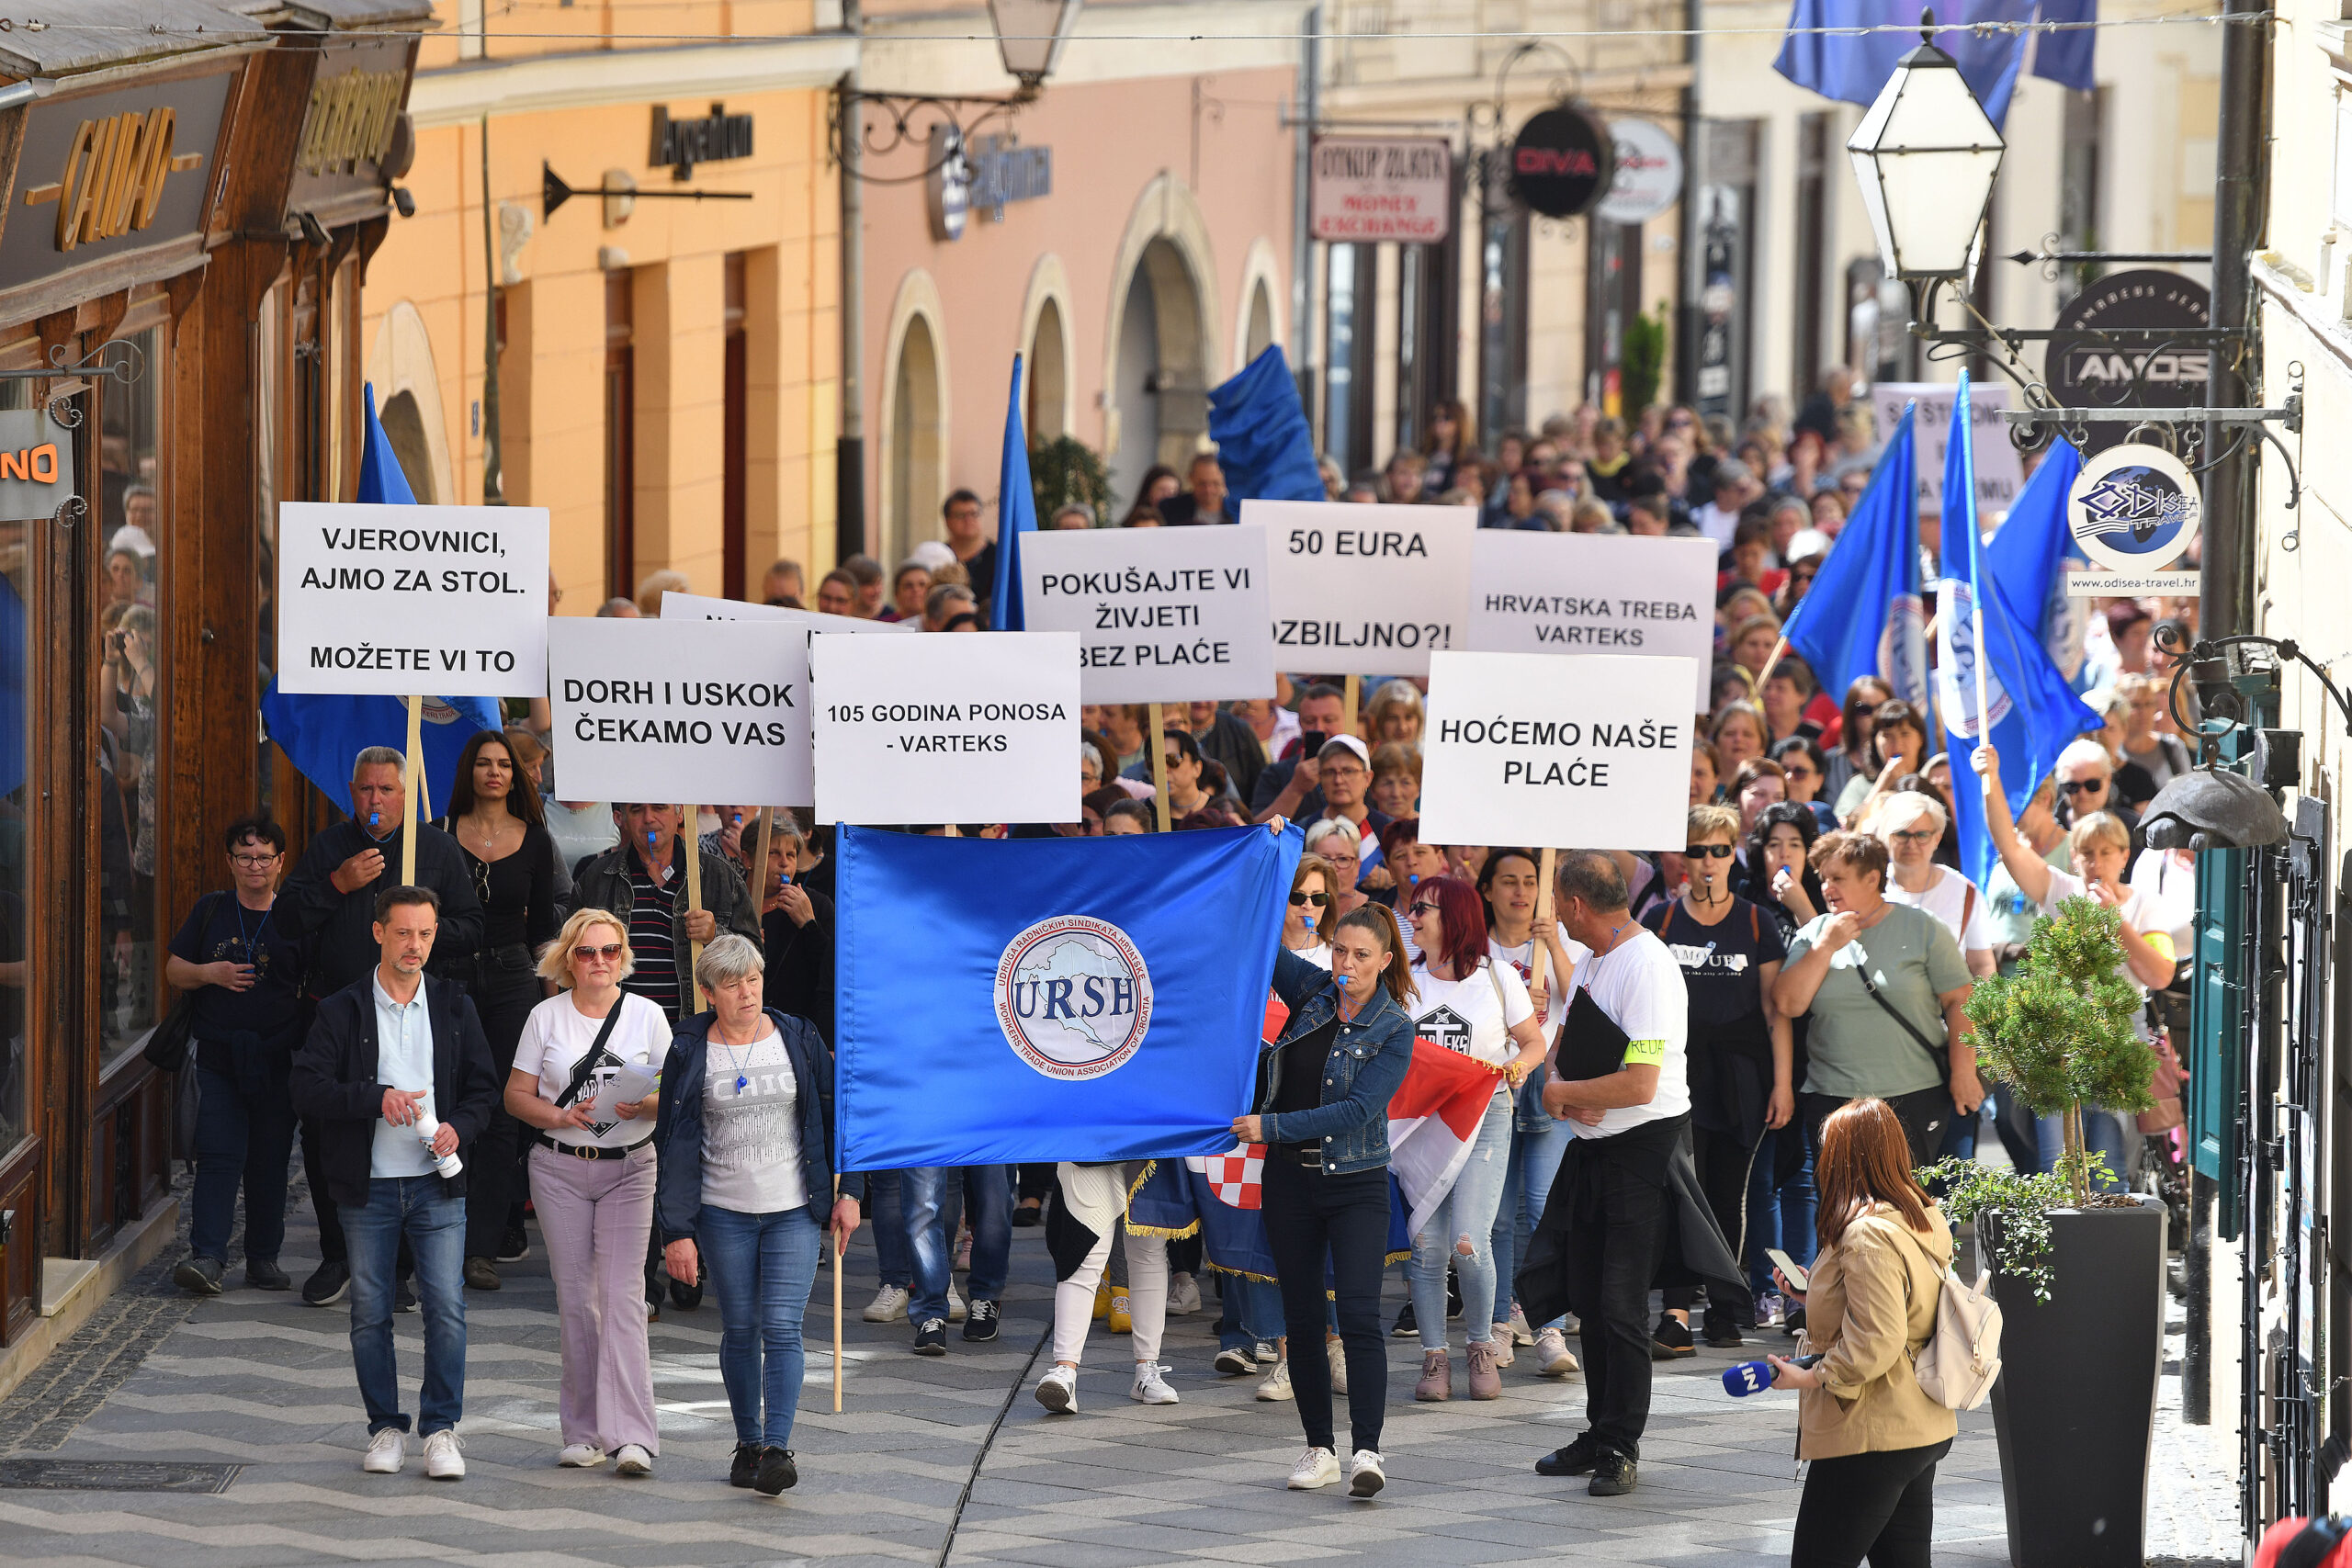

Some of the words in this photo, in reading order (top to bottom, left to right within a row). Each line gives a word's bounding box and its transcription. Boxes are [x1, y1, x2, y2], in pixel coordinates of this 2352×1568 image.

[1516, 148, 1597, 175] DIVA
[1342, 196, 1417, 212] MONEY
[1319, 216, 1435, 234] EXCHANGE
[2165, 289, 2210, 324] JEAN
[2077, 481, 2199, 520] ODISEA
[2132, 513, 2192, 531] TRAVEL
[322, 527, 505, 558] VJEROVNICI,
[1289, 530, 1323, 555] 50
[1336, 531, 1428, 558] EURA
[300, 567, 385, 592] AJMO
[393, 570, 433, 592] ZA
[441, 570, 526, 593] STOL.
[1042, 566, 1214, 595] POKUŠAJTE
[1224, 567, 1250, 589] VI
[2071, 578, 2197, 589] www.odisea-travel.hr
[1095, 603, 1199, 629] ŽIVJETI
[1486, 594, 1611, 616] HRVATSKA
[1621, 600, 1697, 620] TREBA
[1272, 619, 1451, 649] ZBILJNO?!
[1536, 625, 1644, 647] VARTEKS
[311, 642, 430, 671] MOŽETE
[439, 649, 466, 671] VI
[475, 650, 515, 672] TO
[1136, 637, 1230, 666] PLAĆE
[564, 679, 653, 705] DORH
[664, 682, 673, 705] I
[682, 682, 795, 707] USKOK
[828, 705, 865, 722] 105
[871, 704, 962, 722] GODINA
[969, 703, 1067, 721] PONOSA
[575, 712, 712, 745] ČEKAMO
[721, 721, 786, 746] VAS
[899, 734, 1008, 752] VARTEKS
[1441, 715, 1581, 747] HOĆEMO
[1592, 719, 1679, 749] NAŠE
[1504, 757, 1609, 787] PLAĆE
[999, 947, 1019, 987] UDRUGA
[1015, 920, 1066, 948] RADNIČKIH
[1068, 919, 1117, 940] SINDIKATA
[1117, 936, 1147, 981] HRVATSKE
[1015, 976, 1135, 1020] URSH
[999, 1001, 1023, 1046] WORKERS
[1020, 1045, 1046, 1070] TRADE
[1046, 1065, 1075, 1077] UNION
[1077, 1047, 1133, 1077] ASSOCIATION
[1130, 1035, 1141, 1049] OF
[1137, 996, 1150, 1036] CROATIA
